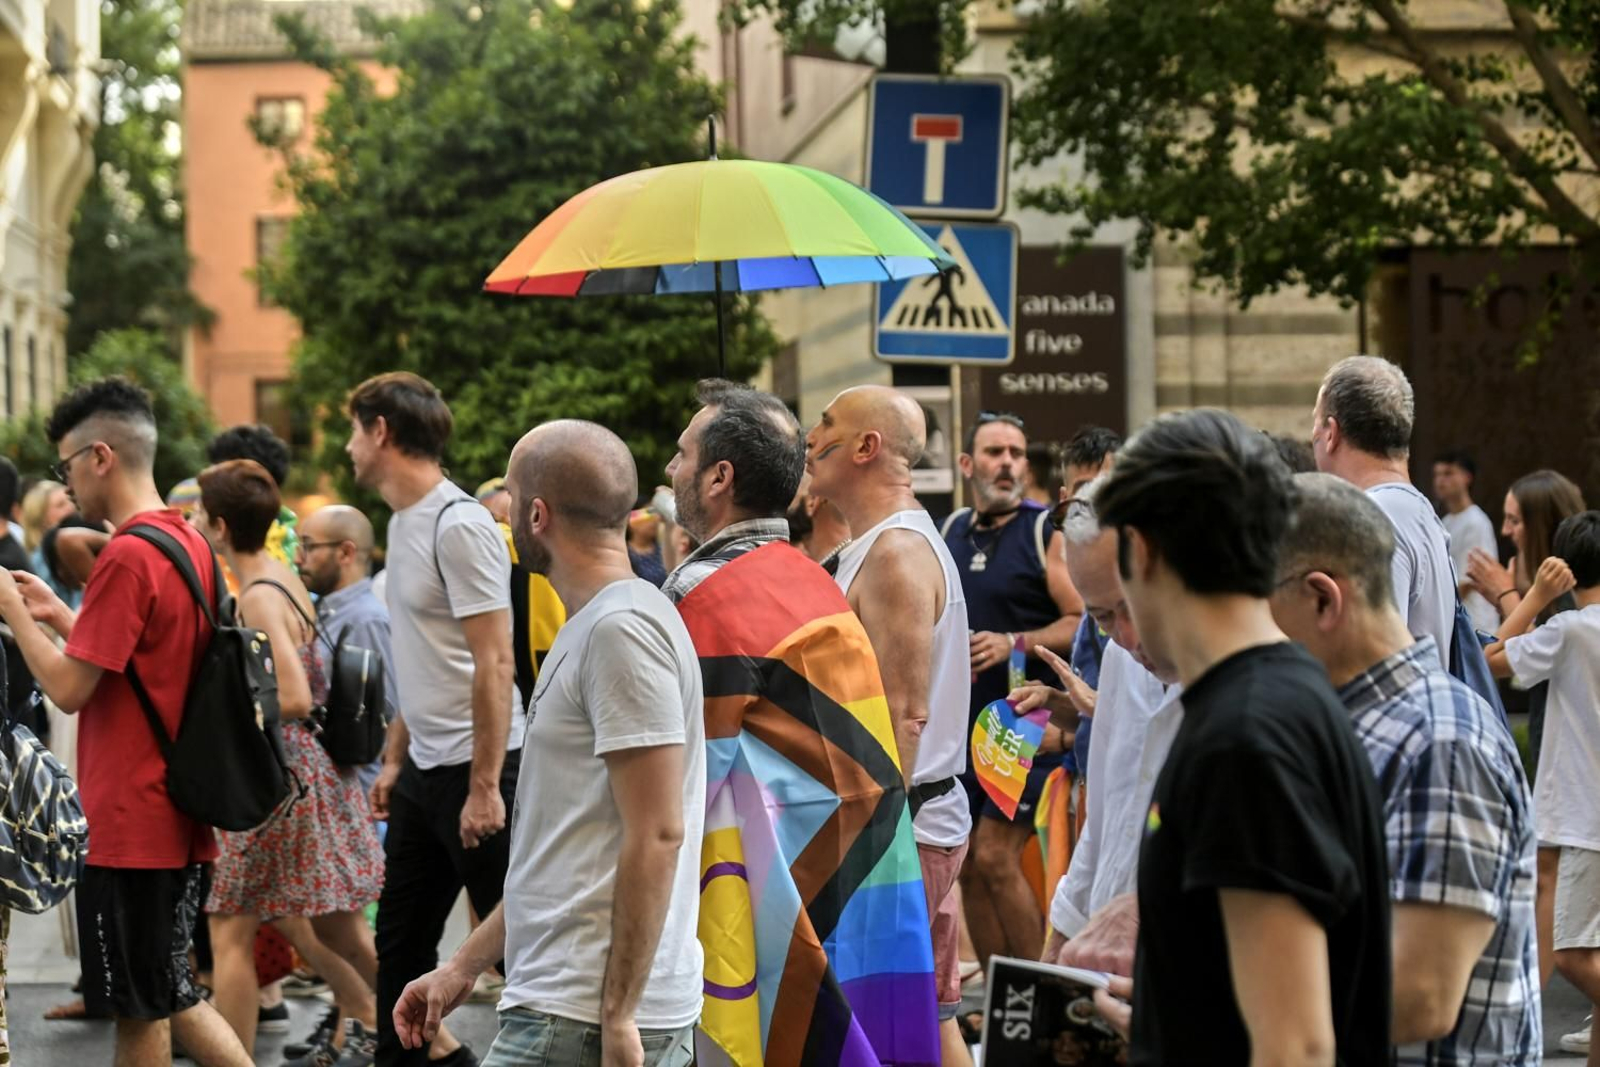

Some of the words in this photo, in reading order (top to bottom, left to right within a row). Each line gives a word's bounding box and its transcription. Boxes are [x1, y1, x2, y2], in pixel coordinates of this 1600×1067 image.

[1018, 291, 1115, 315] anada
[1025, 329, 1083, 354] five
[1000, 372, 1109, 393] senses
[993, 728, 1025, 777] UGR
